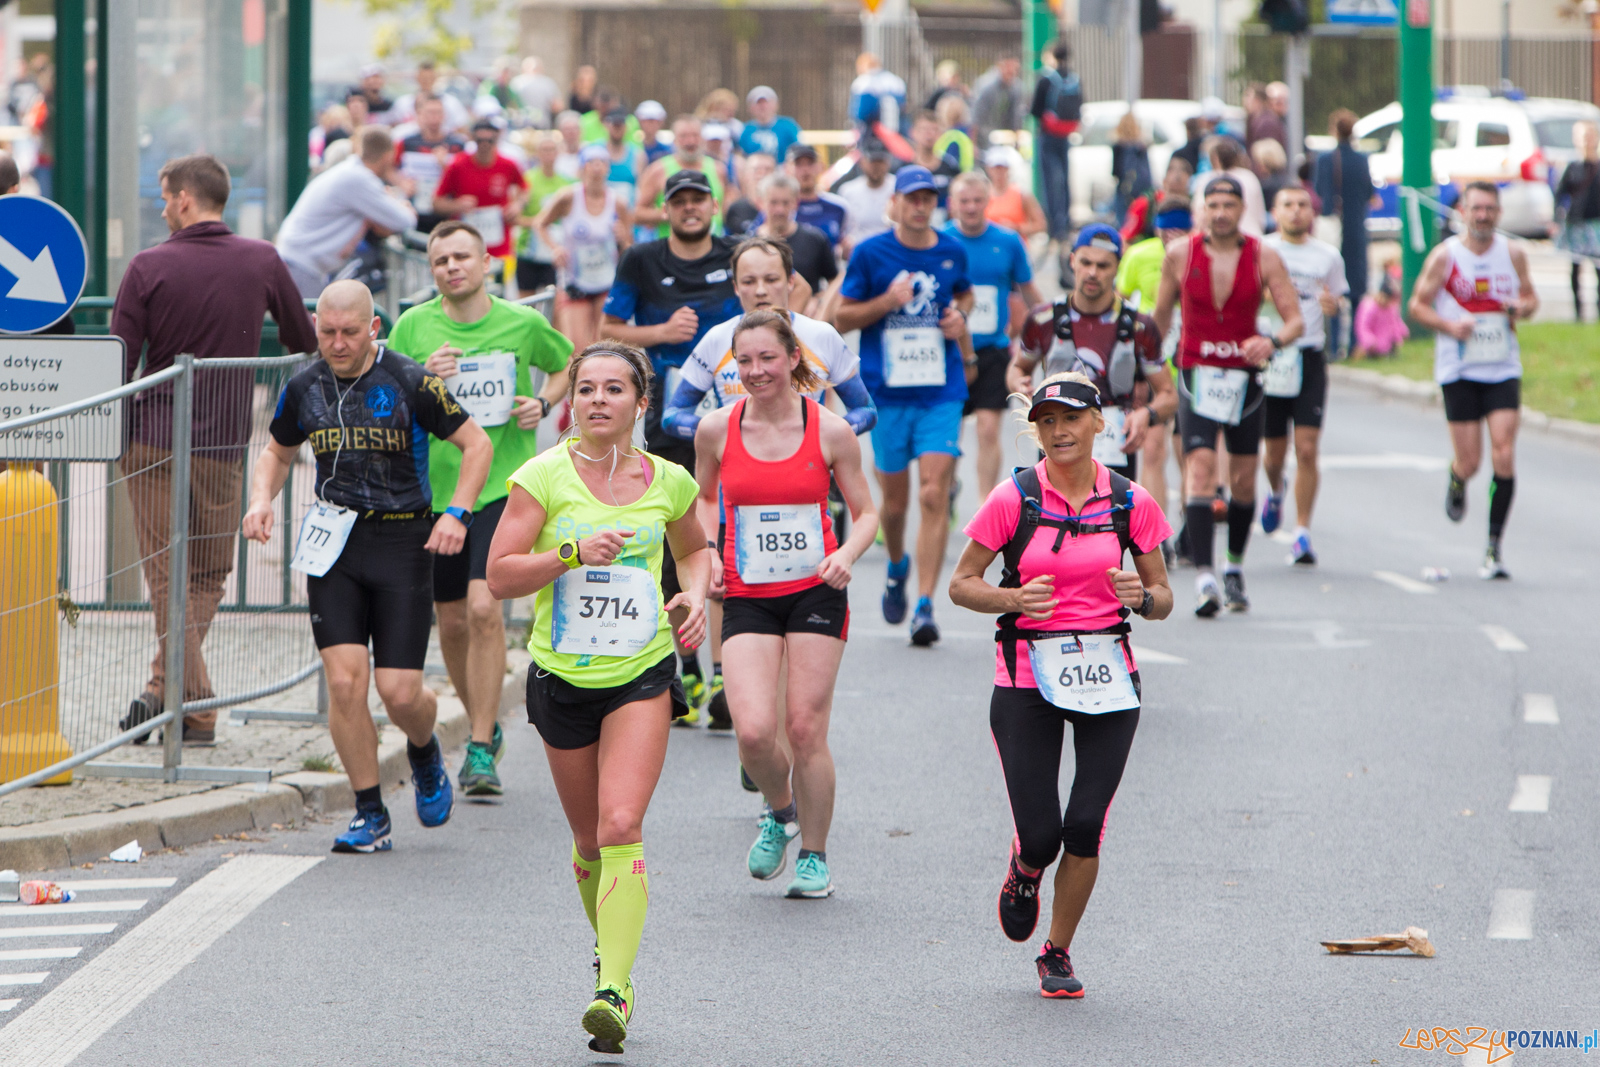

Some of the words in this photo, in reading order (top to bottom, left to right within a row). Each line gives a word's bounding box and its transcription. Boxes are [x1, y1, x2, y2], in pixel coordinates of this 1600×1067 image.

[3, 355, 63, 372] dotyczy
[456, 379, 505, 399] 4401
[306, 524, 332, 547] 777
[756, 532, 807, 552] 1838
[579, 595, 639, 620] 3714
[1059, 664, 1113, 687] 6148
